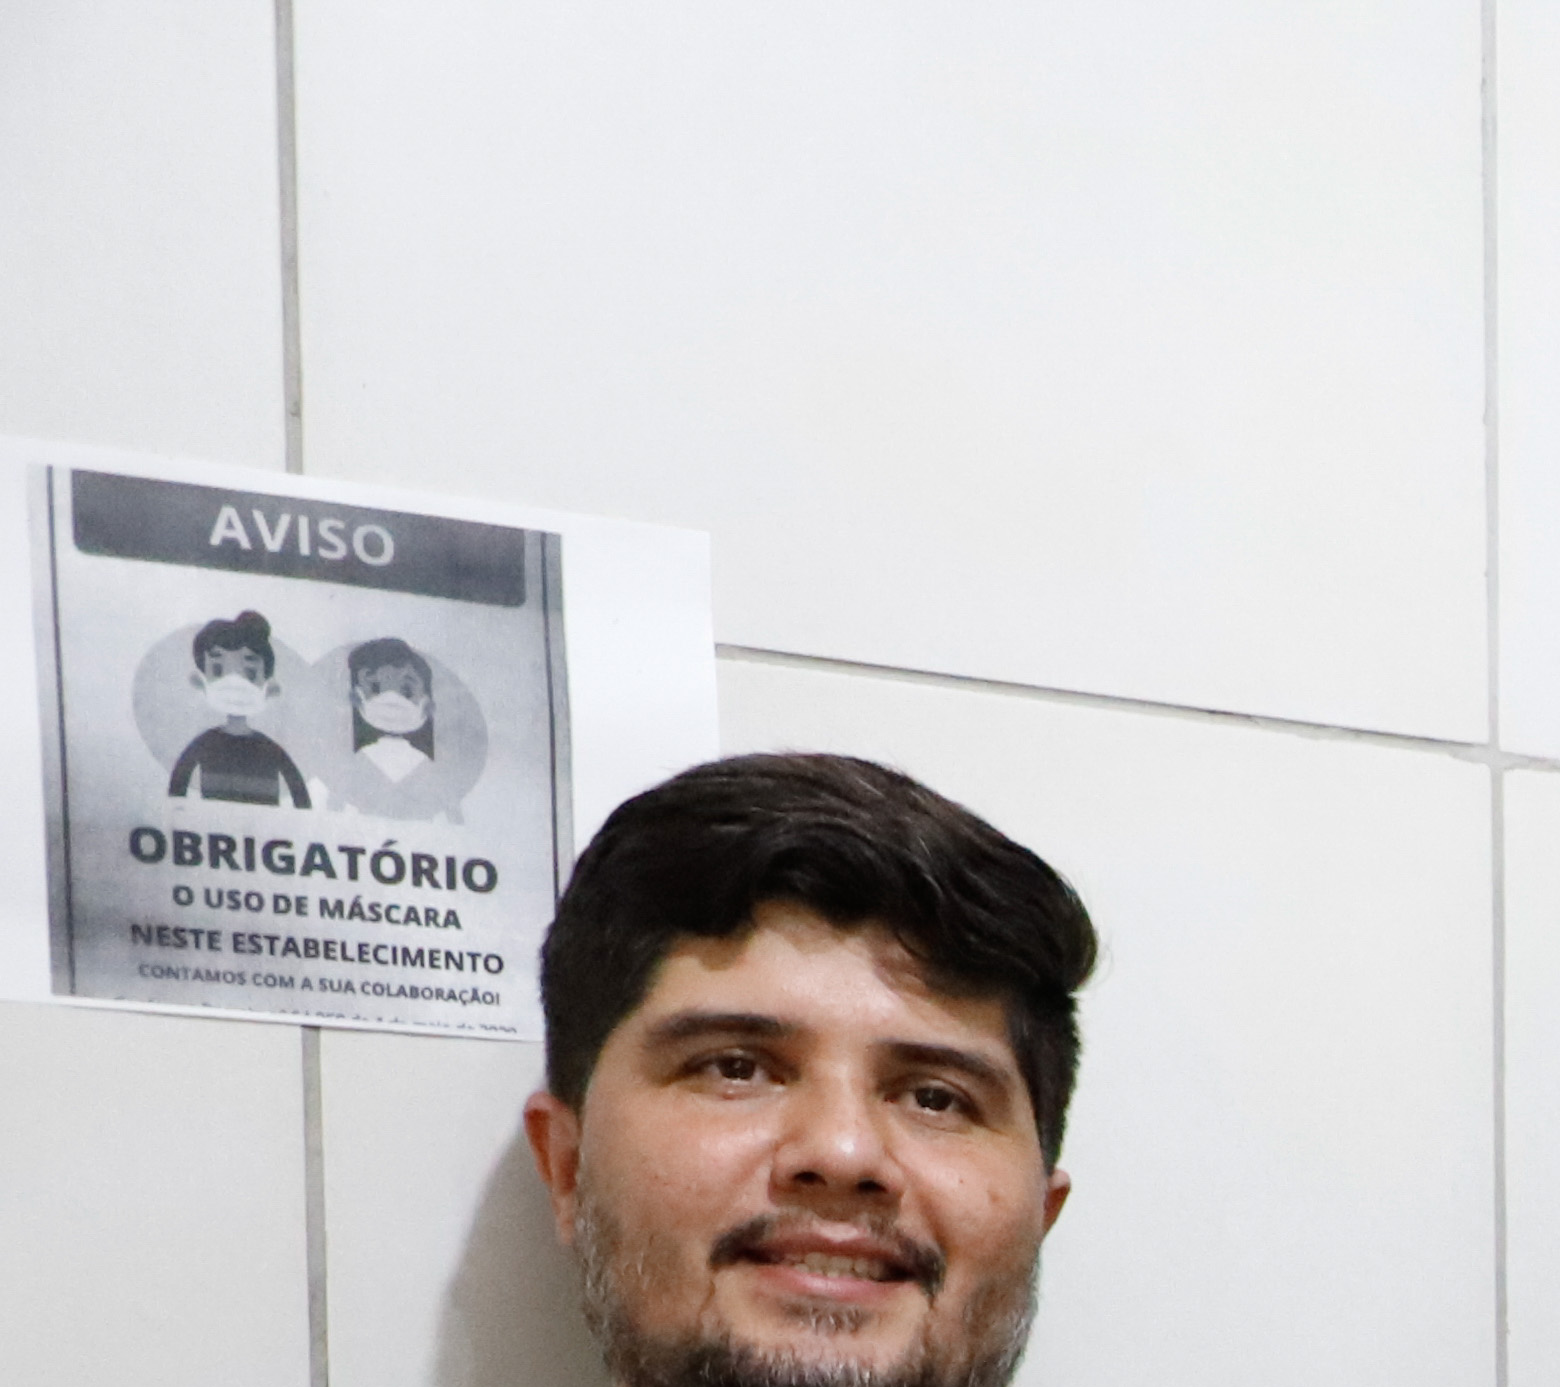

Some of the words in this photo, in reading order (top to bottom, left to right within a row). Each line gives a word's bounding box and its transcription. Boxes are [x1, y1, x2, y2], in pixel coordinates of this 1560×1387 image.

[208, 504, 395, 568] AVISO
[128, 826, 499, 894] OBRIGATÓRIO
[172, 885, 194, 907] O
[203, 888, 265, 915] USO
[272, 894, 309, 918] DE
[318, 893, 462, 931] MÁSCARA
[130, 922, 223, 953] NESTE
[232, 930, 504, 977] ESTABELECIMENTO
[137, 961, 247, 989] CONTAMOS
[251, 972, 295, 991] COM
[300, 975, 315, 993] A
[318, 976, 356, 998] SUA
[361, 980, 500, 1008] COLABORAÇÃO!
